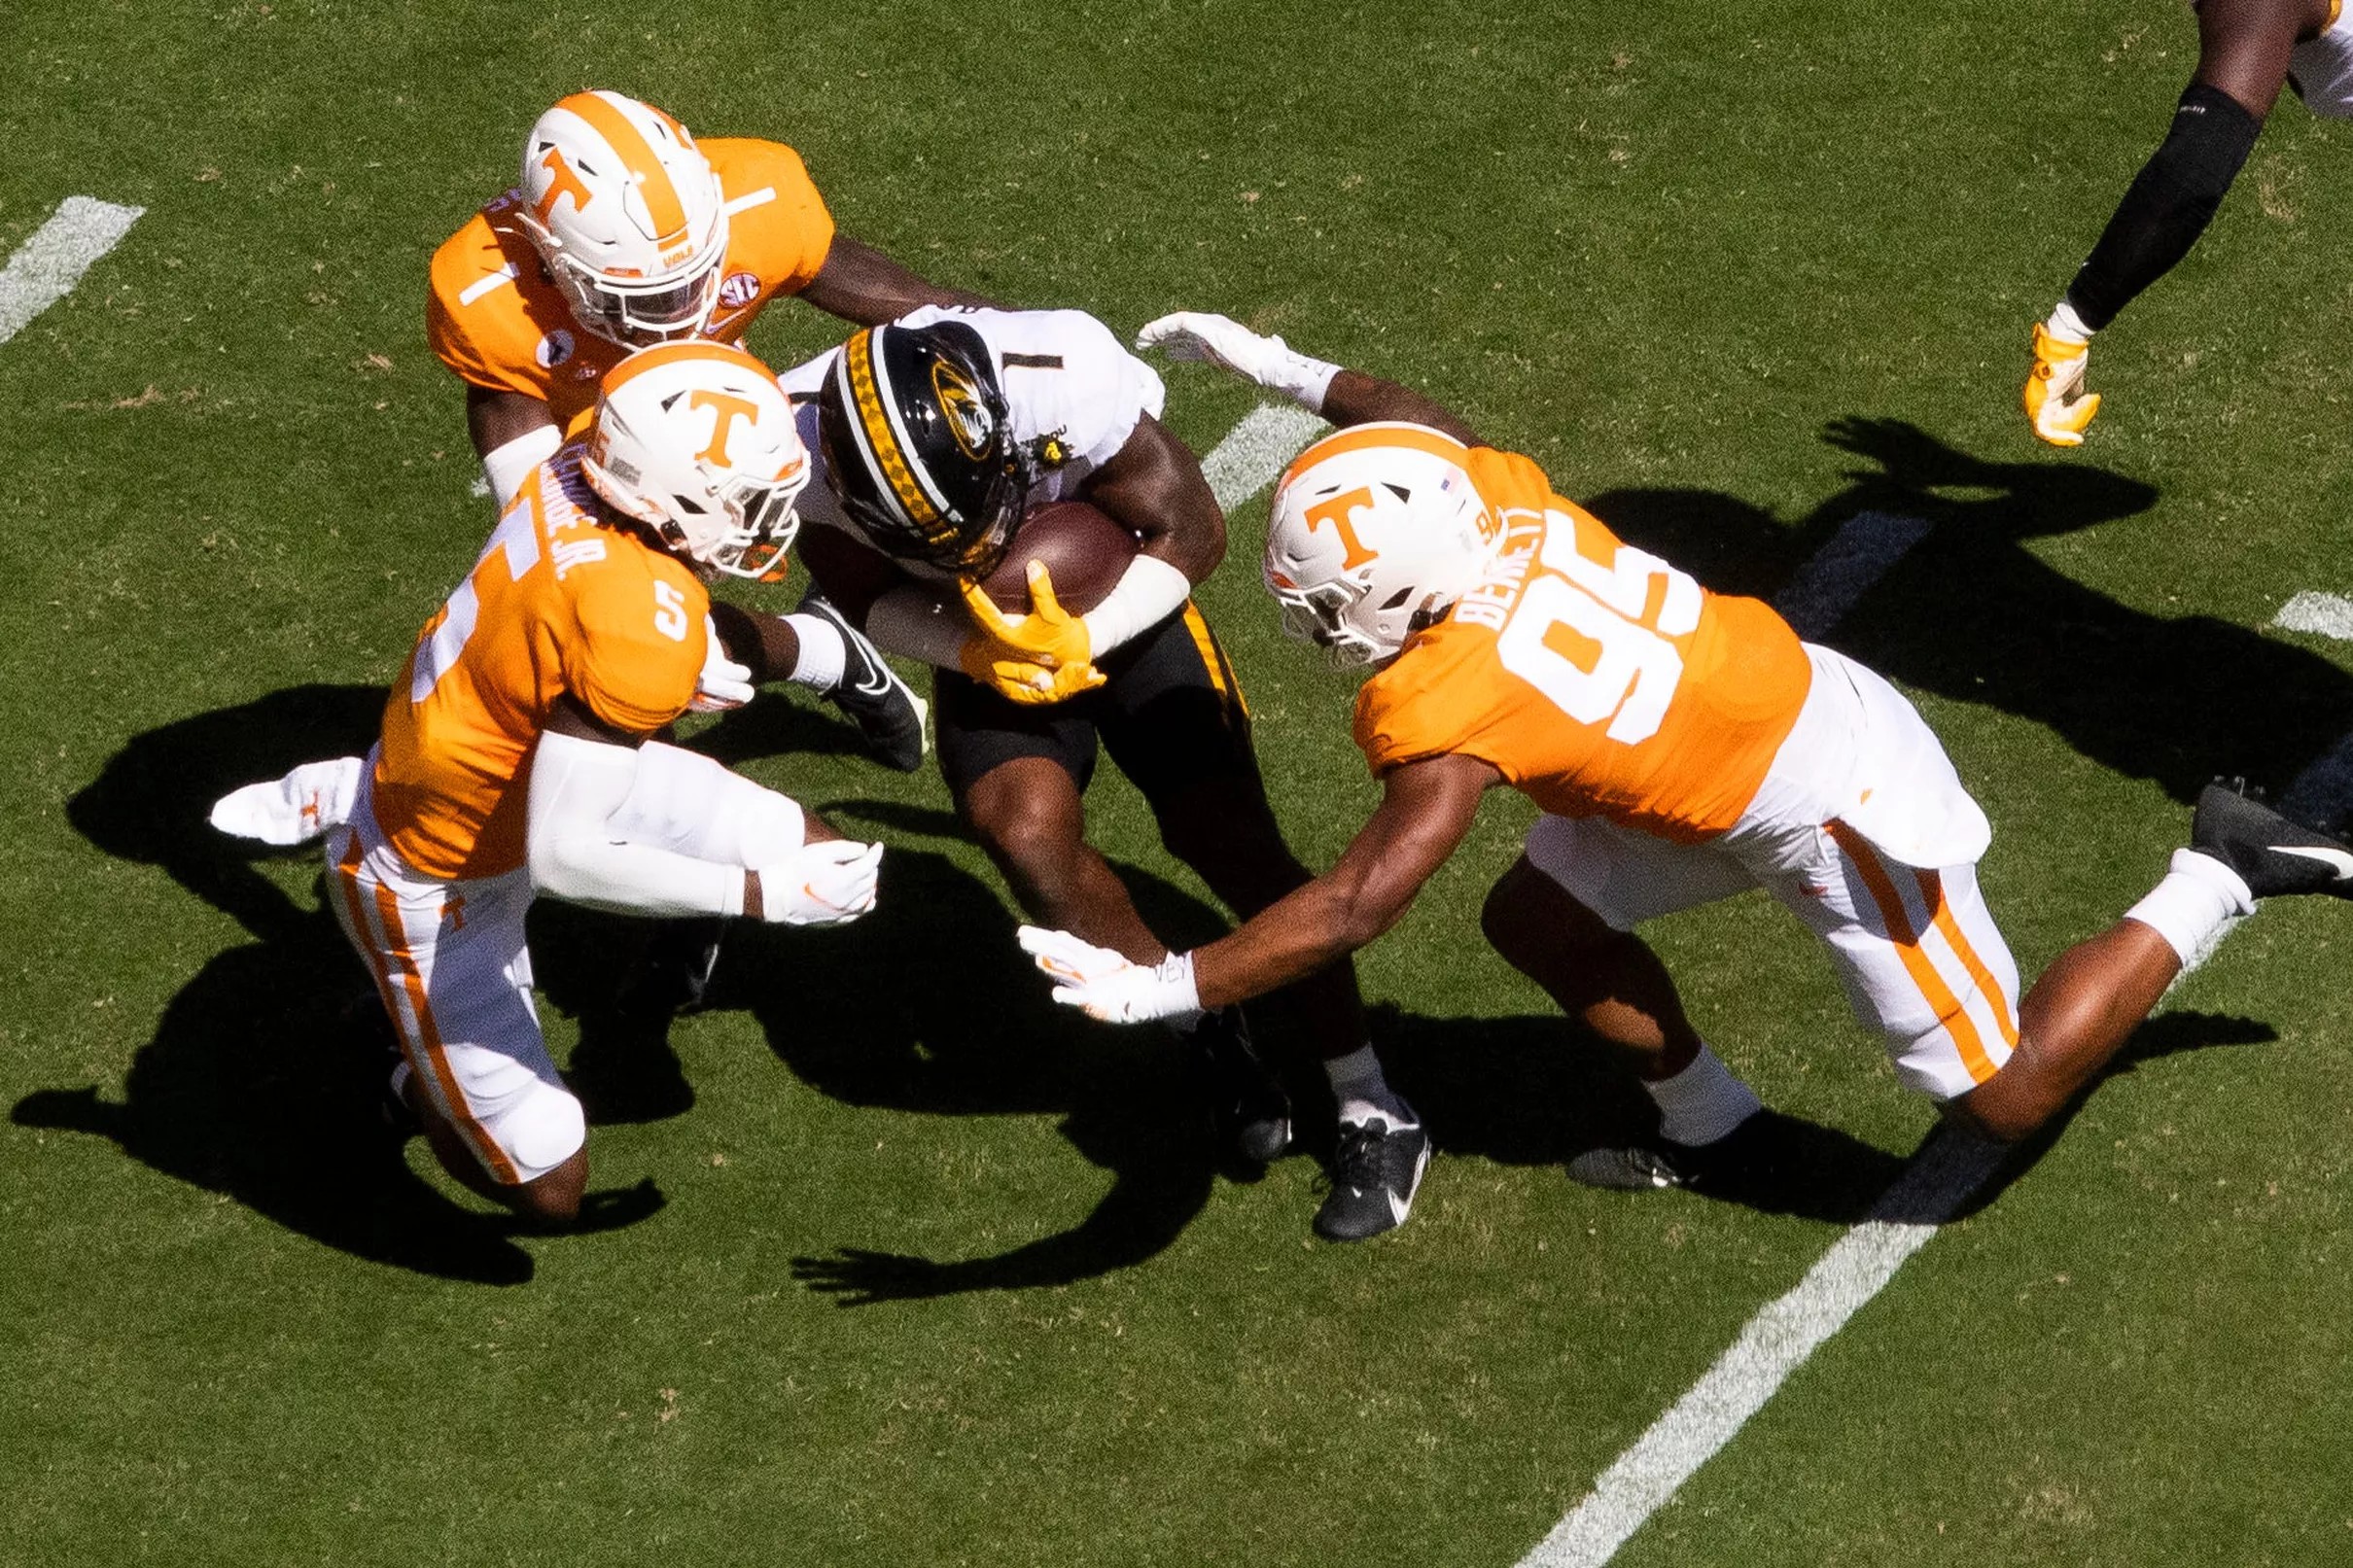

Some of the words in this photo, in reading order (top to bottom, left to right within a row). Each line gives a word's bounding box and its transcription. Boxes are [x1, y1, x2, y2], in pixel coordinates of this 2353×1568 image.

[531, 146, 592, 233] T
[689, 390, 759, 469] T
[1304, 486, 1380, 572] T
[653, 580, 687, 642] 5
[1496, 508, 1702, 746] 95
